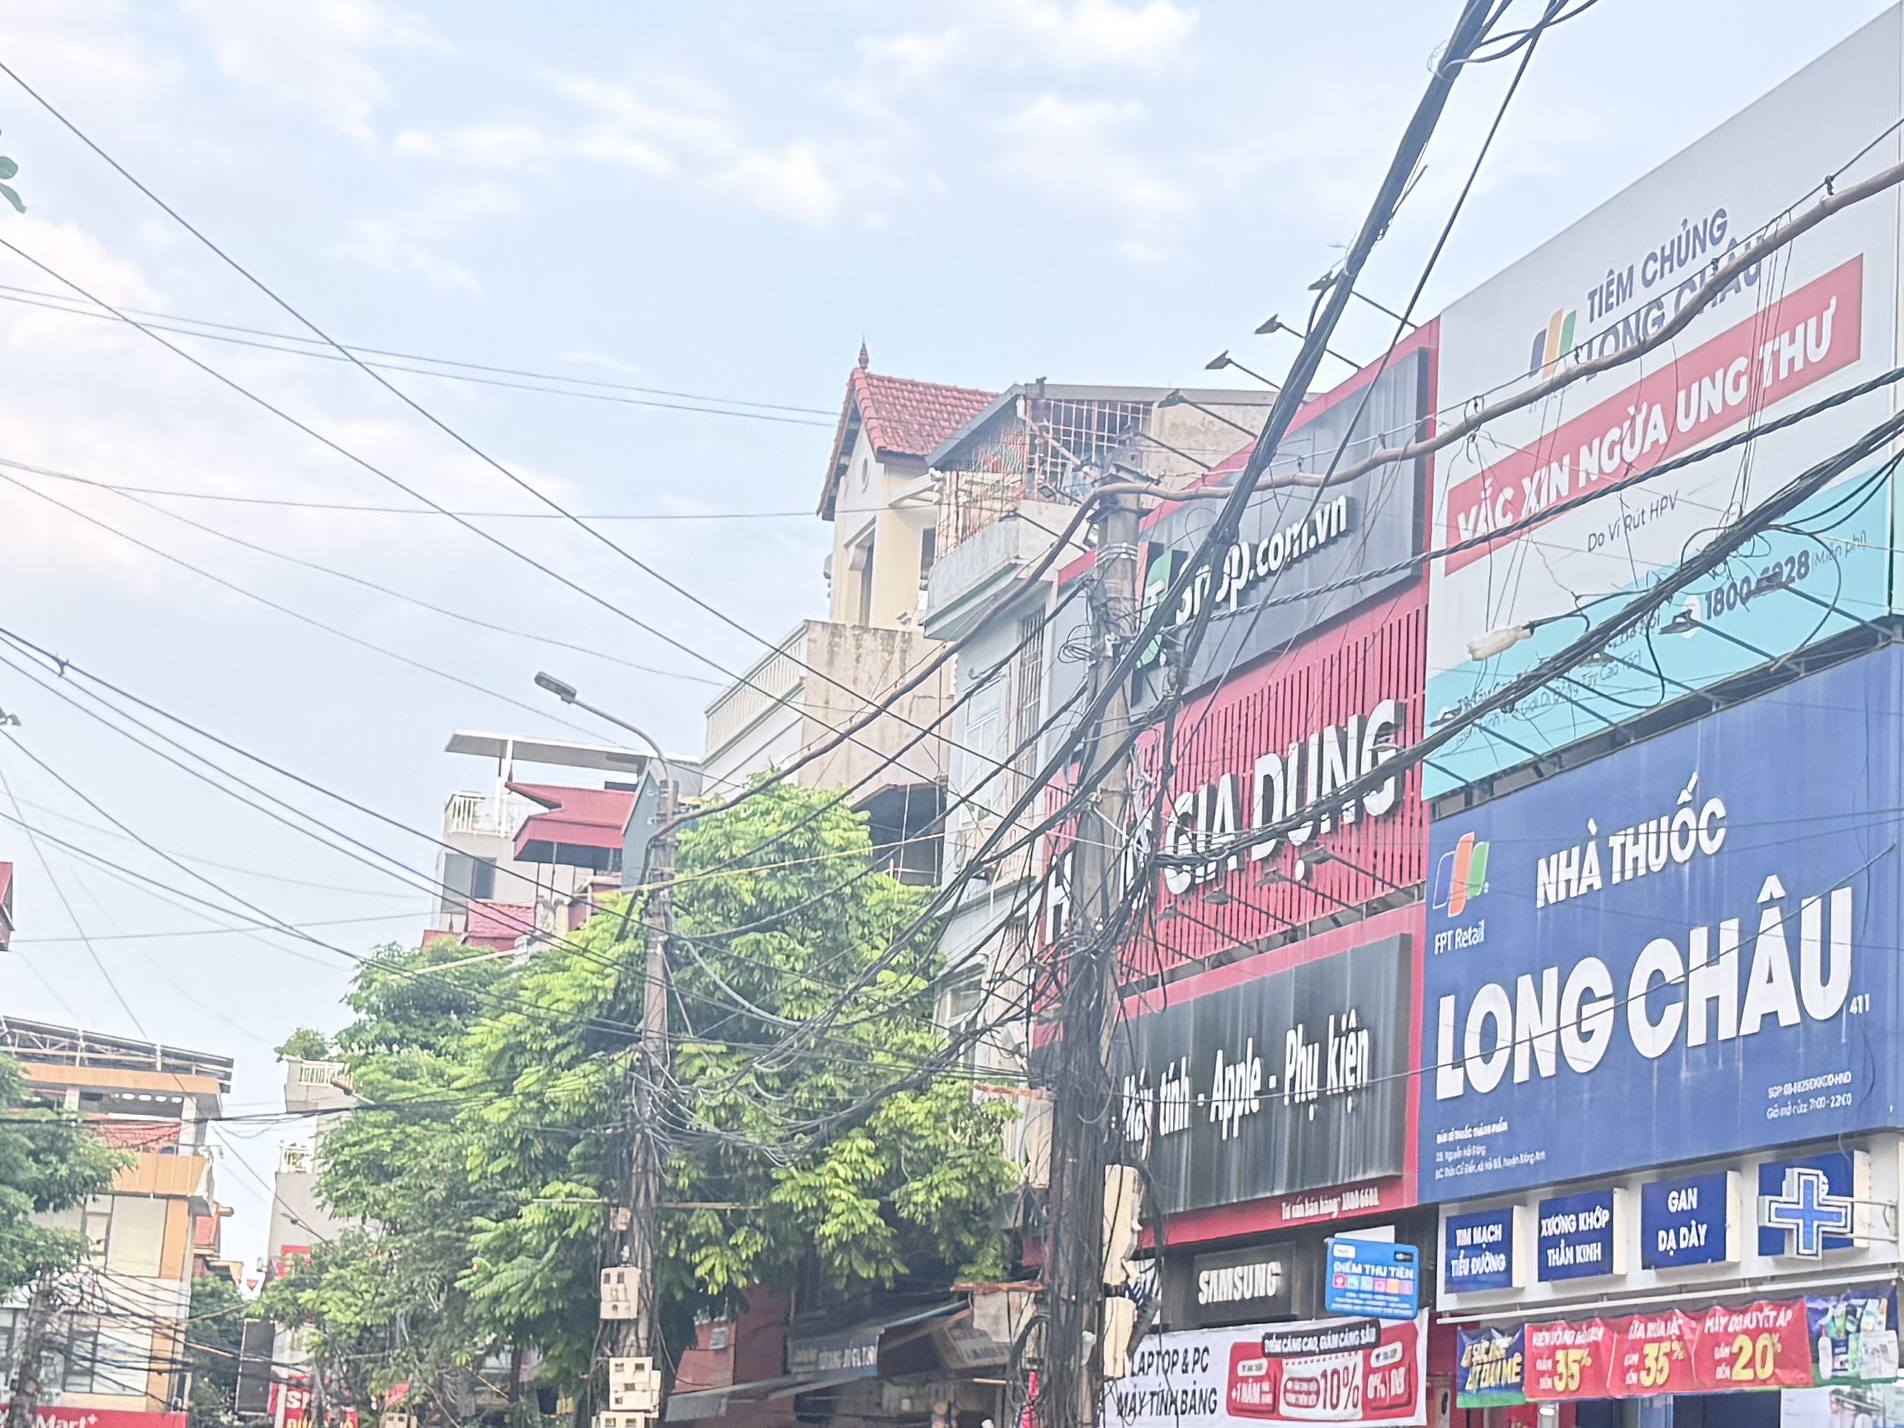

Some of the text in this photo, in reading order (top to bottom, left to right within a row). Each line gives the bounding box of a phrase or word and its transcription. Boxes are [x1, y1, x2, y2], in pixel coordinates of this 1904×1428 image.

[1587, 208, 1728, 323] TIÊM CHỦNG
[1519, 452, 1573, 520] XIN
[1579, 404, 1667, 488] NGỪA
[1677, 363, 1748, 433] UNG
[1759, 296, 1836, 390] THƯ
[1588, 531, 1606, 554] Do
[1649, 488, 1681, 523] HPV
[1536, 772, 1727, 909] NHÀ THUỐC
[1434, 919, 1485, 955] FPT Retail
[1437, 874, 1853, 1101] LONG CHÂU
[1849, 993, 1870, 1015] 411
[1160, 1057, 1191, 1136] tính
[1210, 1037, 1262, 1140] Apple
[1284, 1024, 1319, 1121] Phụ
[1326, 1008, 1369, 1113] kiện
[1668, 1187, 1697, 1213] GAN
[1473, 1224, 1502, 1248] MẠCH
[1657, 1220, 1708, 1255] DẠ DÀY
[1199, 1260, 1282, 1305] SAMSUNG
[1193, 1346, 1210, 1373] PC
[1553, 1347, 1592, 1392] 35%
[1640, 1340, 1686, 1387] 35%
[1732, 1333, 1782, 1381] 20%
[1180, 1379, 1217, 1416] BẢNG
[1320, 1362, 1360, 1410] 10%
